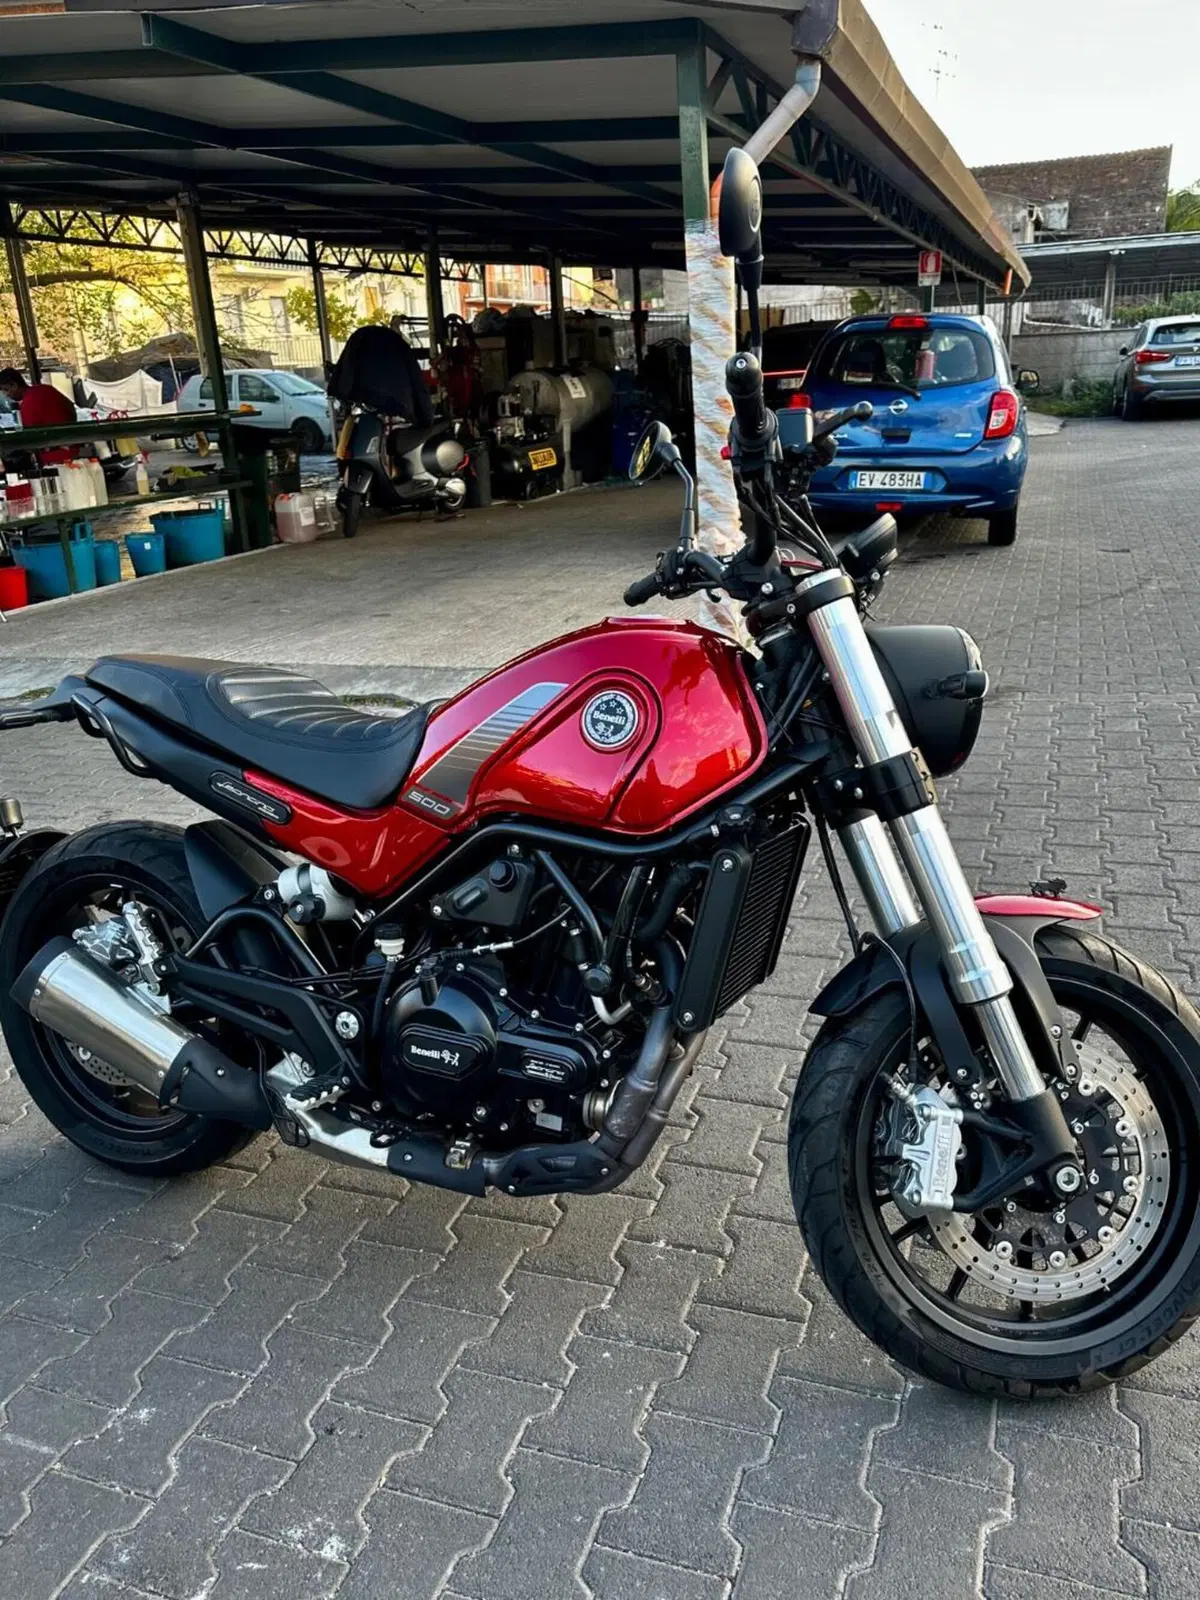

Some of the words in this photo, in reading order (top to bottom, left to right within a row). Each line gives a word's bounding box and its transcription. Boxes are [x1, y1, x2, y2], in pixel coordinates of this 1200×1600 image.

[859, 472, 875, 487] EV
[880, 473, 922, 487] 483HA
[592, 710, 626, 725] Benelli
[408, 790, 451, 815] 500
[411, 1044, 440, 1060] Benelli
[932, 1131, 951, 1188] Benelli
